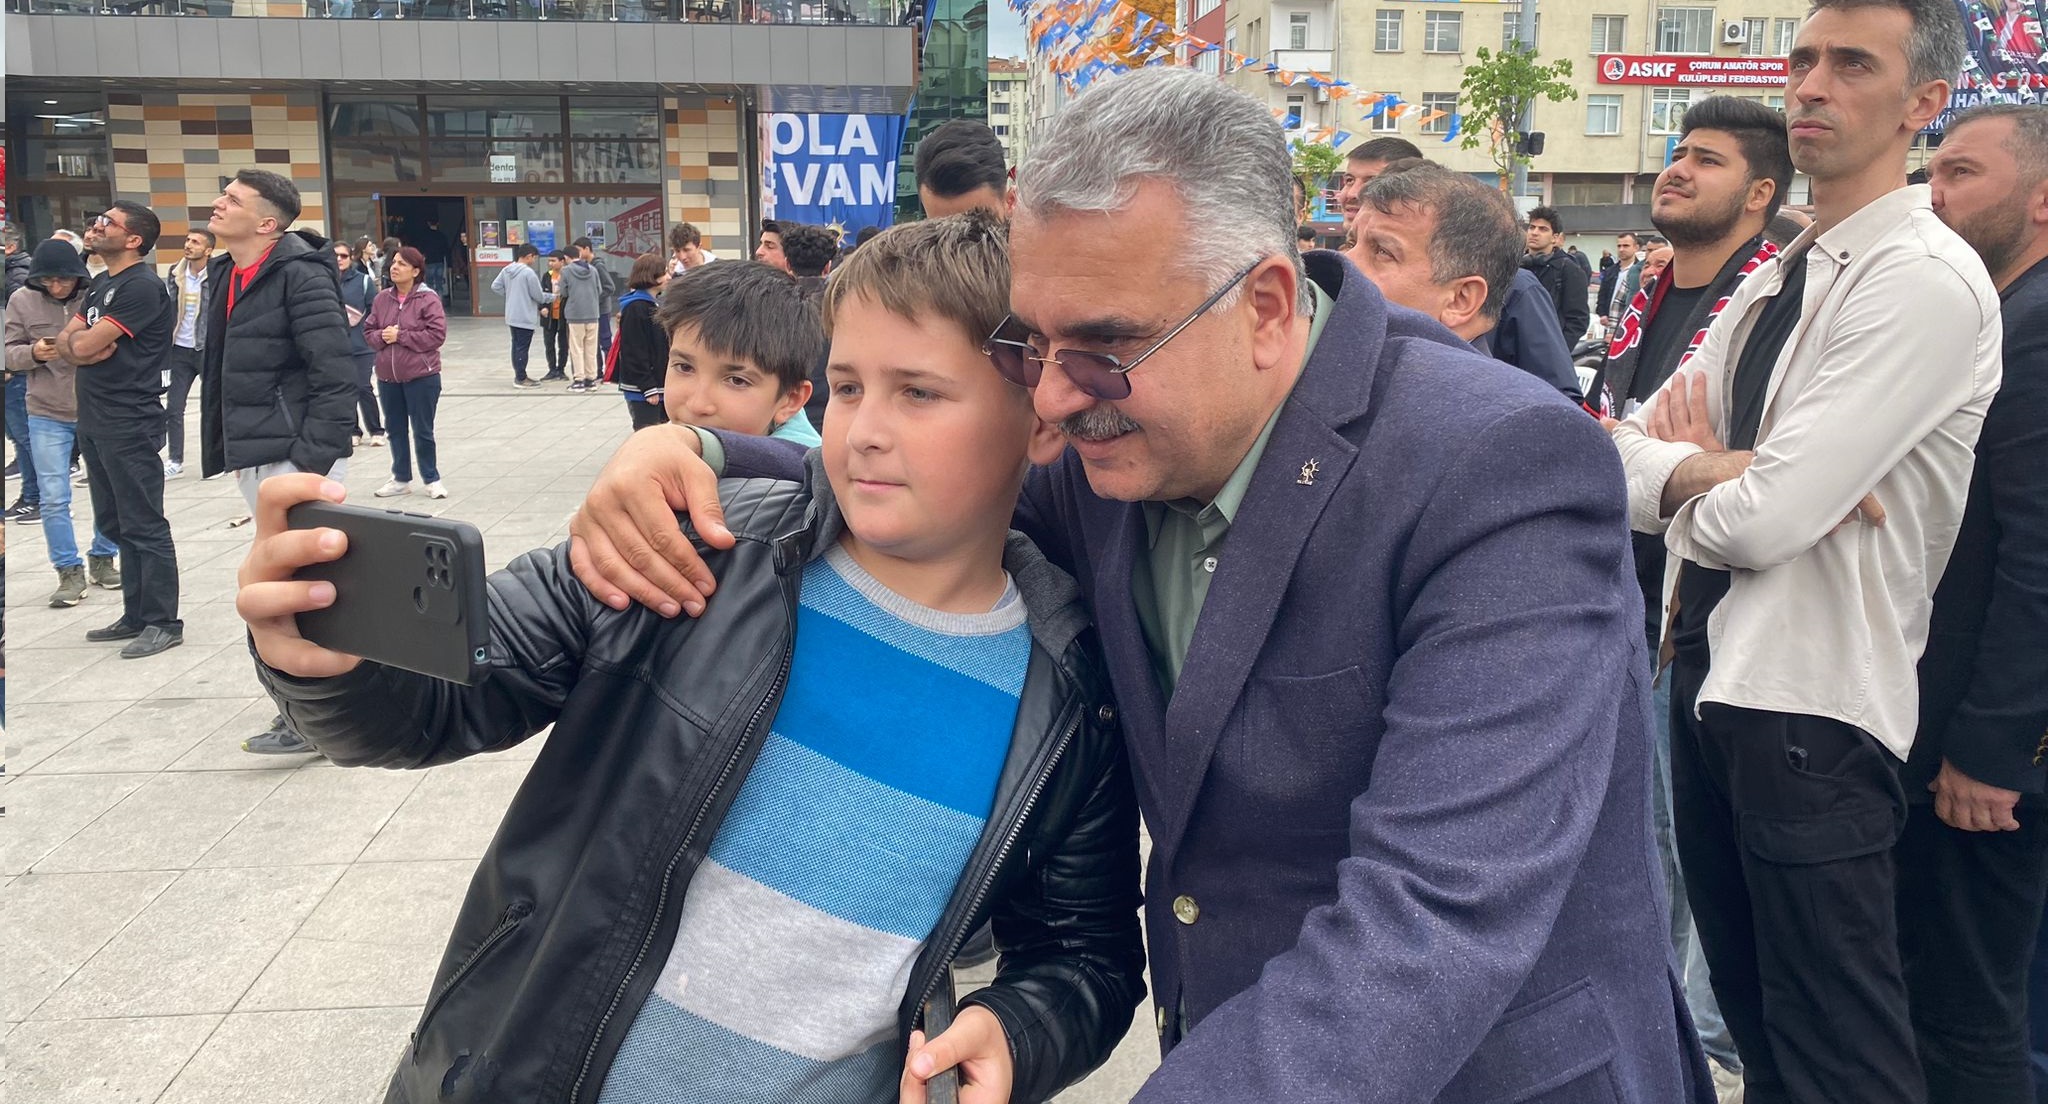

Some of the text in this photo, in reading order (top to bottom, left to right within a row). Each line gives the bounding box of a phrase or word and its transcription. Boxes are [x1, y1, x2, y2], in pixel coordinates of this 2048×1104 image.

[1628, 60, 1783, 78] ASKF ÇORUM AMATÖR SPOR
[1678, 73, 1788, 84] KULÜPLERİ FEDERASYON
[773, 160, 896, 206] VAM
